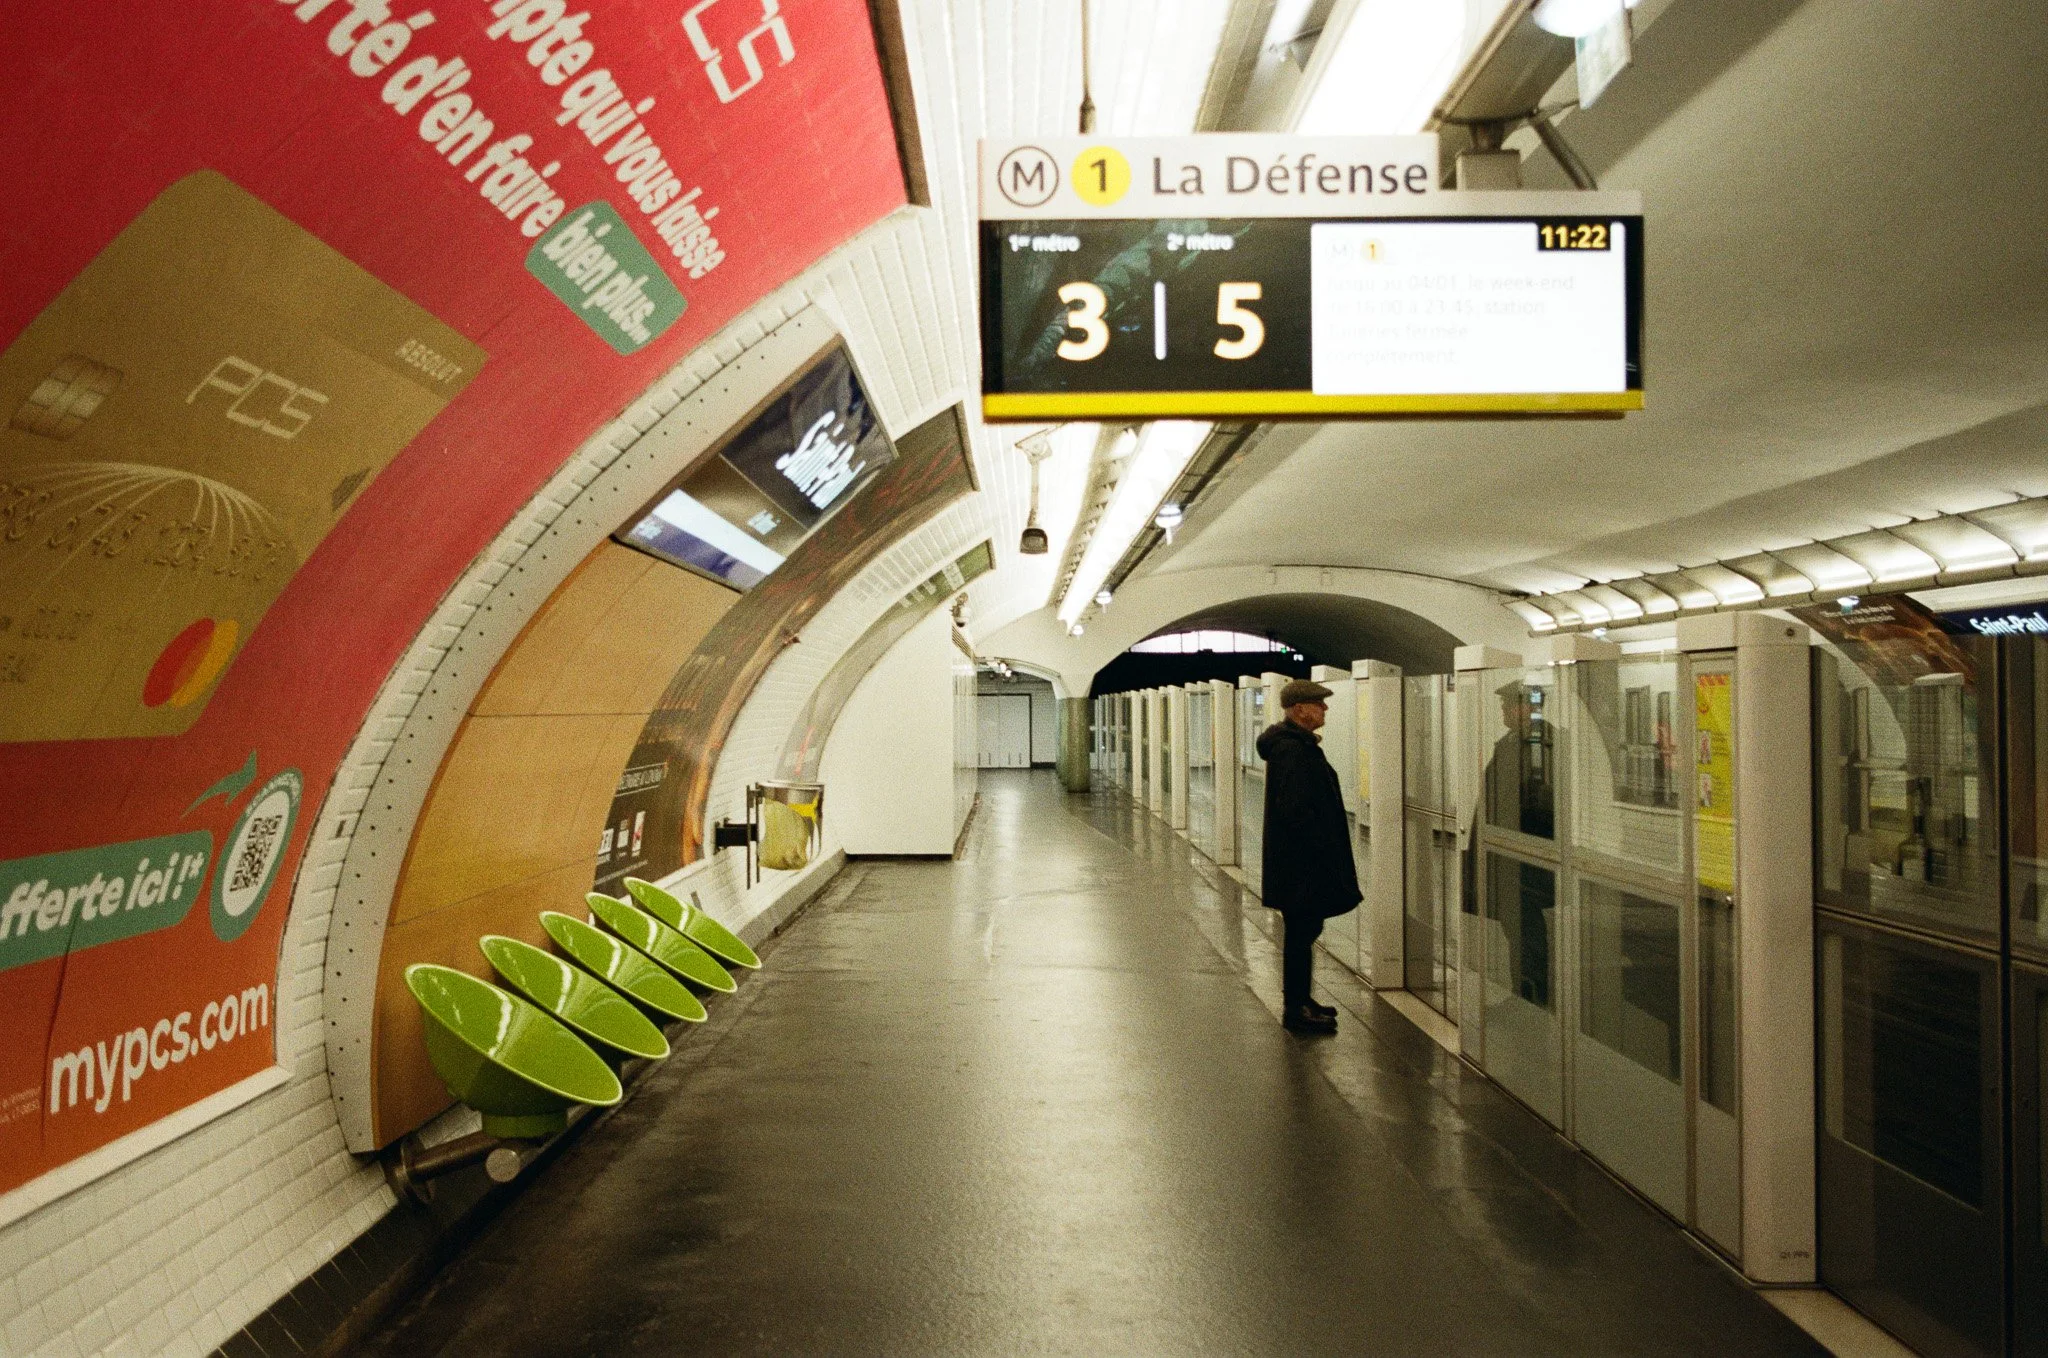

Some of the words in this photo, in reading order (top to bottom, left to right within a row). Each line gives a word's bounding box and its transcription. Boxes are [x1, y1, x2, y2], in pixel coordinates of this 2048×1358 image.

[381, 55, 494, 166] d'en
[464, 133, 565, 237] faire
[555, 68, 656, 147] qui
[603, 122, 682, 214] vous
[1090, 158, 1107, 193] 1
[1153, 157, 1204, 196] La
[1226, 153, 1429, 196] Défense
[542, 210, 618, 293] bien
[651, 187, 726, 279] laisse
[1541, 224, 1607, 249] 11:22
[1057, 282, 1110, 361] 3
[1213, 282, 1265, 361] 5
[186, 355, 329, 440] PCS
[1968, 611, 2048, 637] Saint-Paul
[50, 983, 268, 1114] mypcs.com
